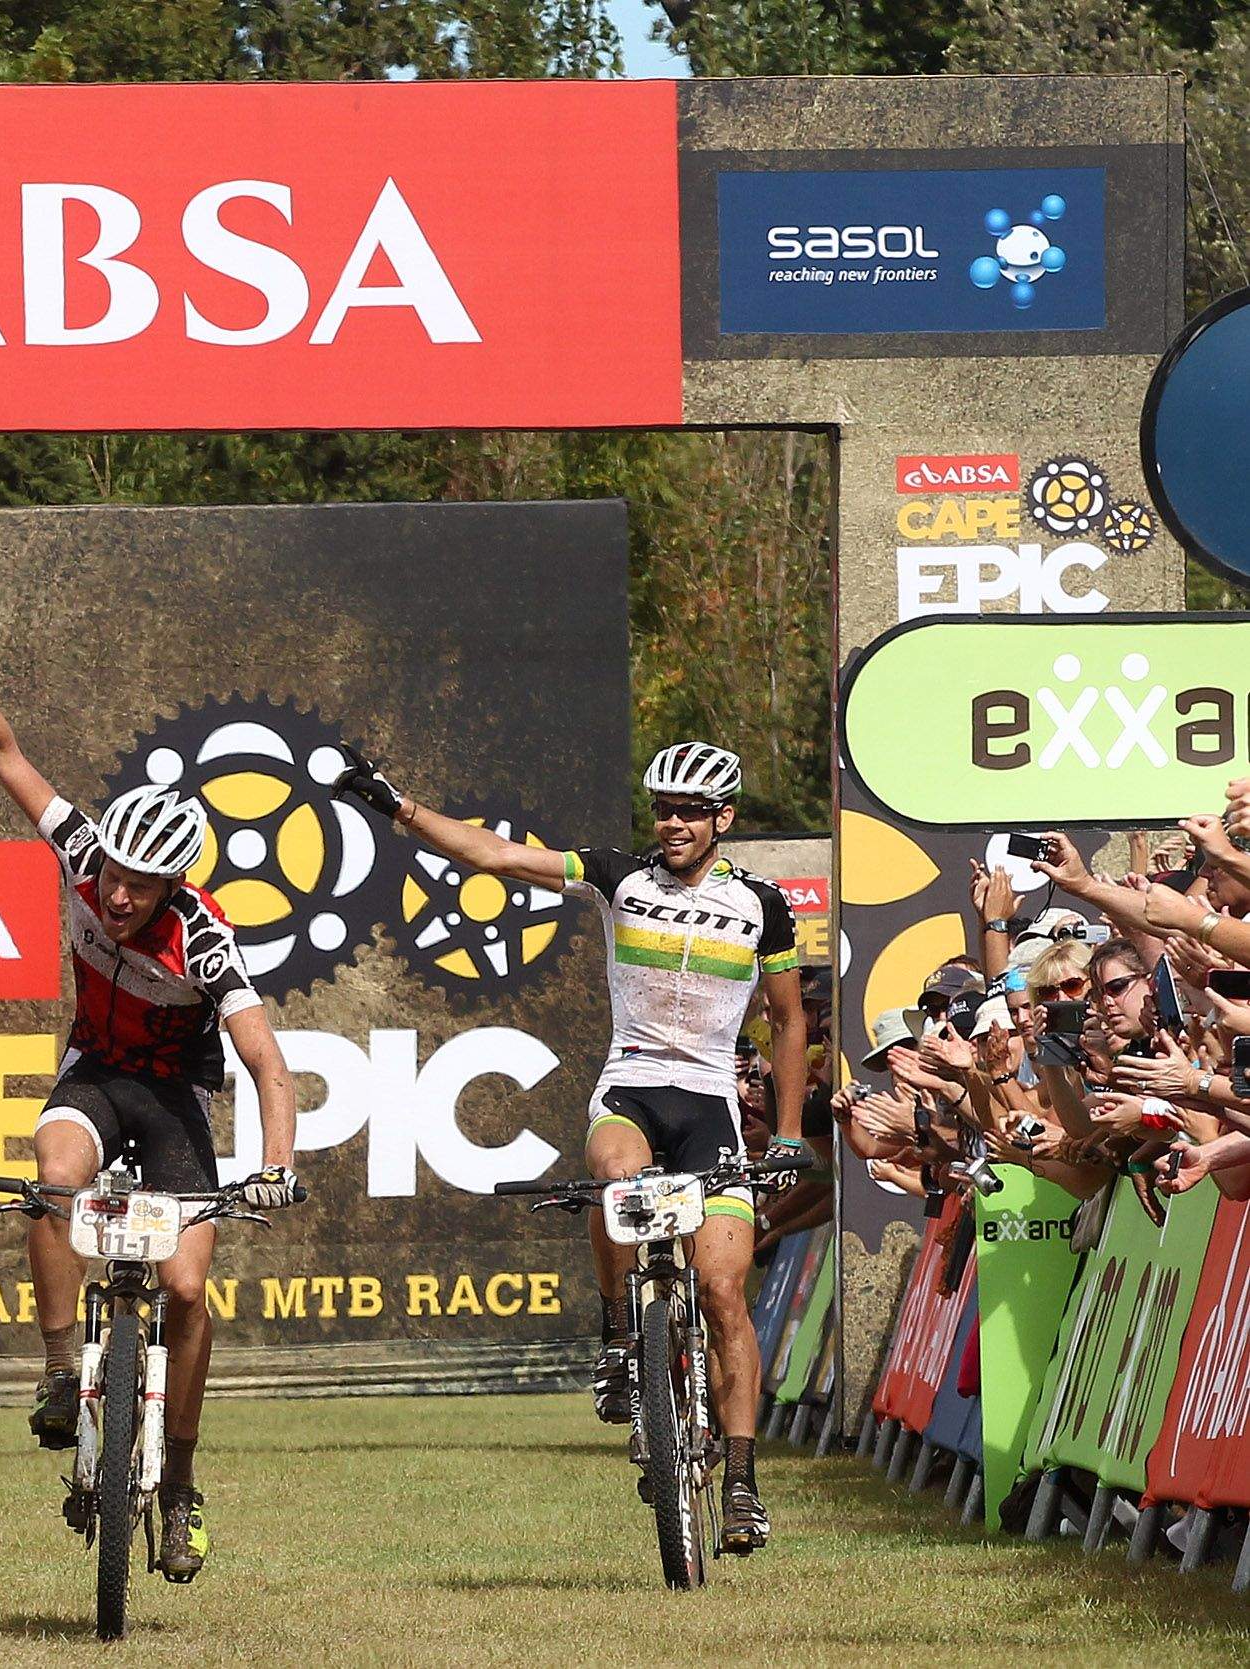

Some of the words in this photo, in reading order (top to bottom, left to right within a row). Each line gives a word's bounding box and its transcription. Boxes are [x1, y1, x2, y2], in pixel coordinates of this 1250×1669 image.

[769, 267, 834, 285] reaching
[838, 269, 869, 282] new
[873, 266, 937, 285] frontiers
[942, 466, 1011, 485] ABSA
[897, 499, 1020, 540] CAPE
[897, 542, 1110, 621] EPIC
[971, 653, 1250, 770] exxa
[619, 896, 760, 936] SCOTT
[102, 1233, 150, 1258] 11-1
[261, 1276, 383, 1318] MTB
[406, 1273, 562, 1316] RACE
